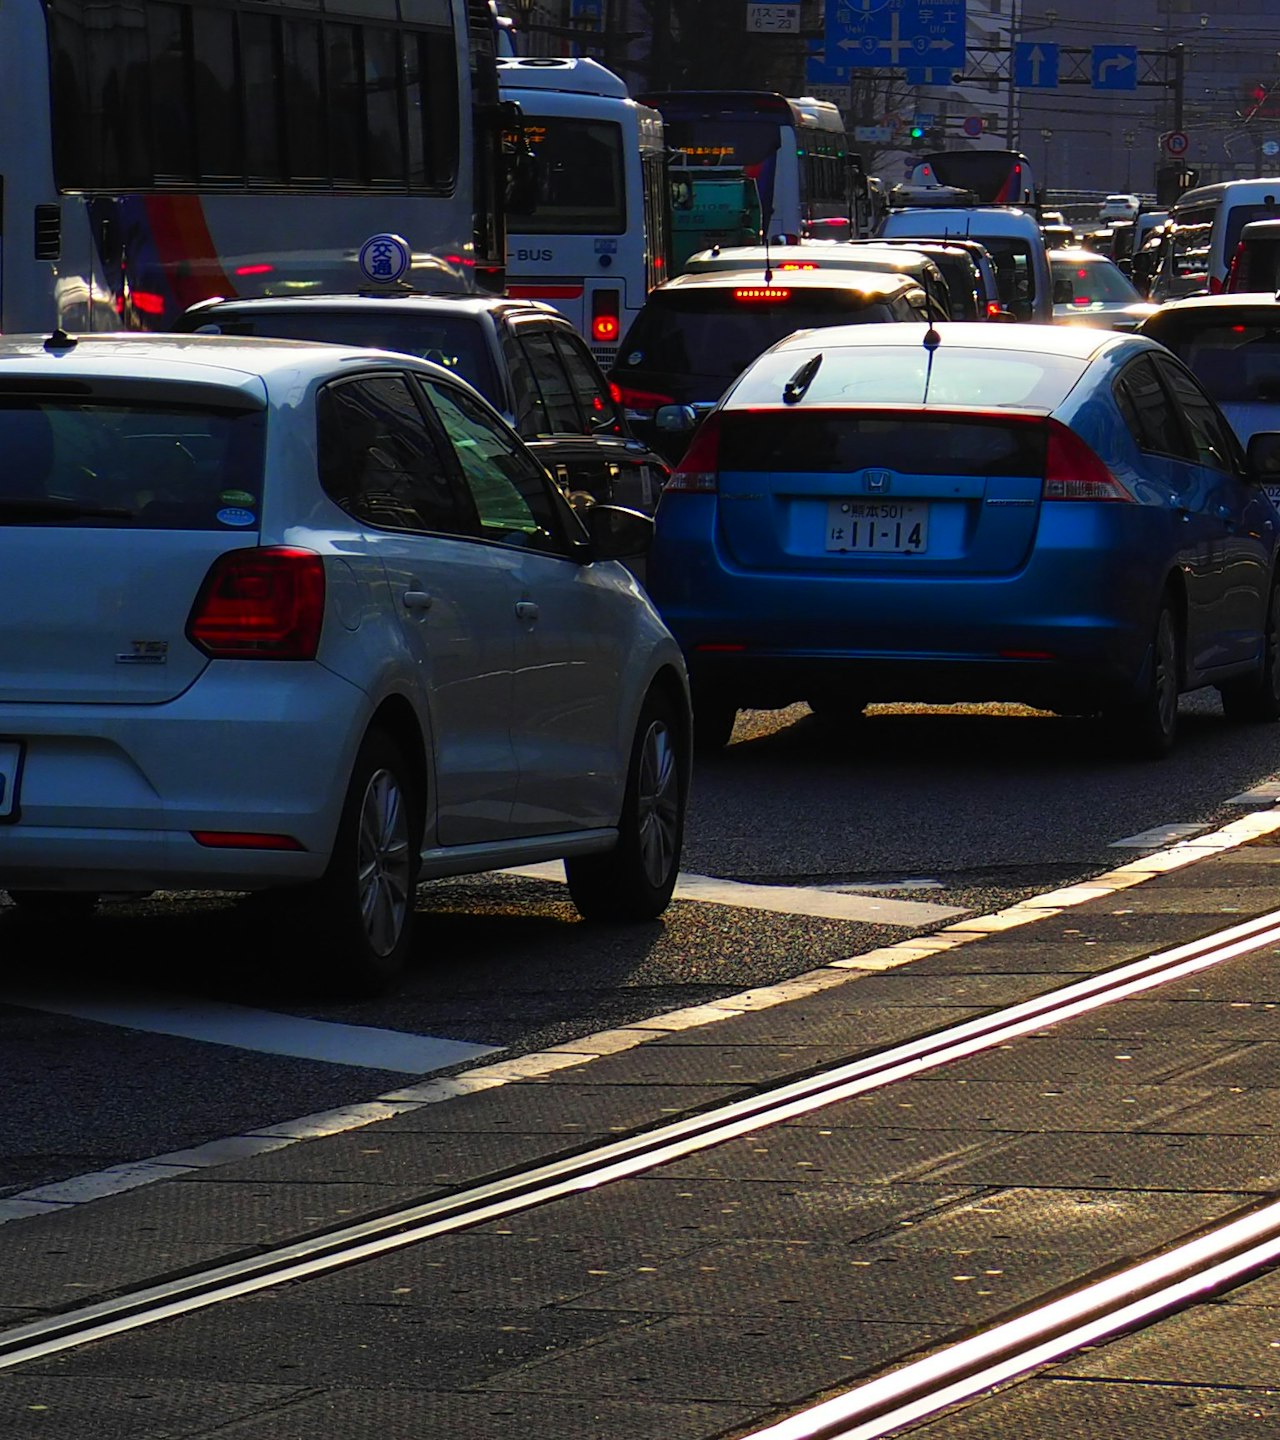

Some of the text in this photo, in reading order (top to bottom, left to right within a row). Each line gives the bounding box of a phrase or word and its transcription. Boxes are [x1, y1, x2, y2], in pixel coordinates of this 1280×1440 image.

[918, 10, 958, 25] 宇土
[372, 243, 393, 275] 交通
[831, 521, 922, 548] は 11-14
